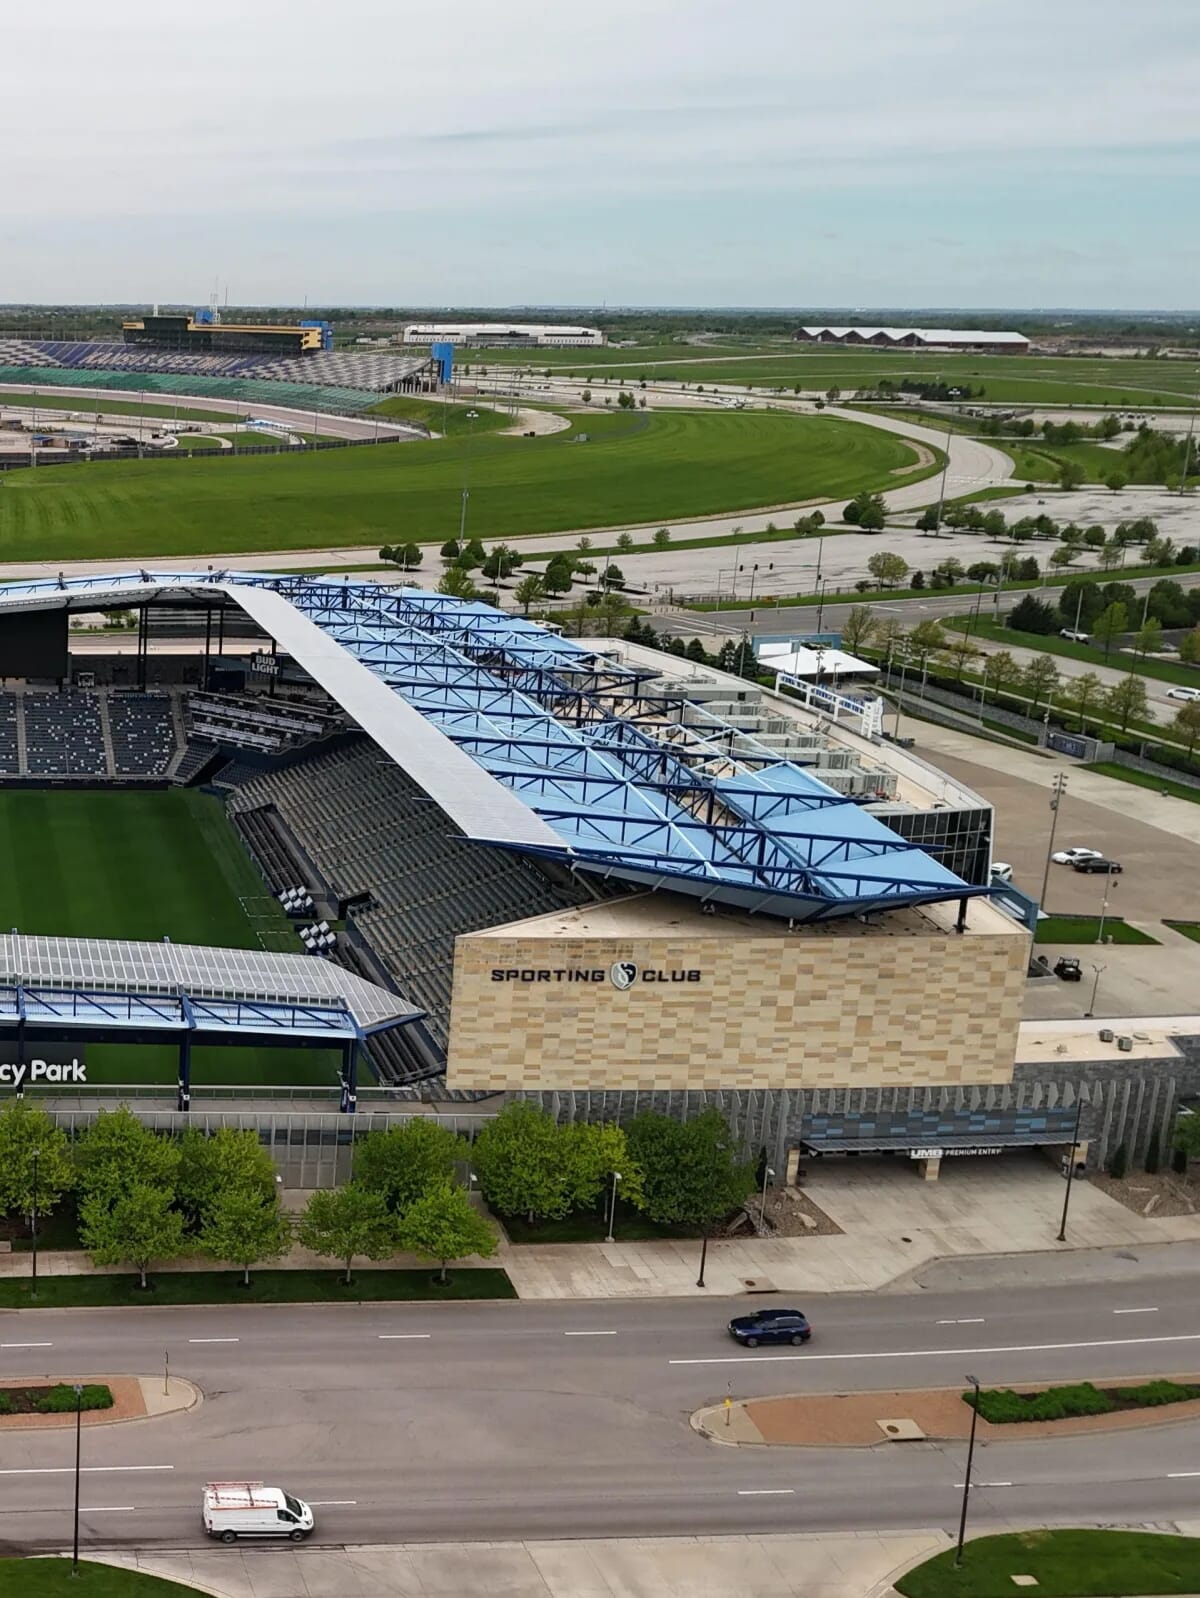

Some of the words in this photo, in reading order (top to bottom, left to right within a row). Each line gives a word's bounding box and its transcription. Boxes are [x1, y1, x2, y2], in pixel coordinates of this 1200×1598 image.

[256, 656, 276, 665] BUD
[252, 663, 279, 674] LIGHT
[491, 969, 605, 982] SPORTING
[641, 969, 701, 982] CLUB
[30, 1058, 87, 1082] Park
